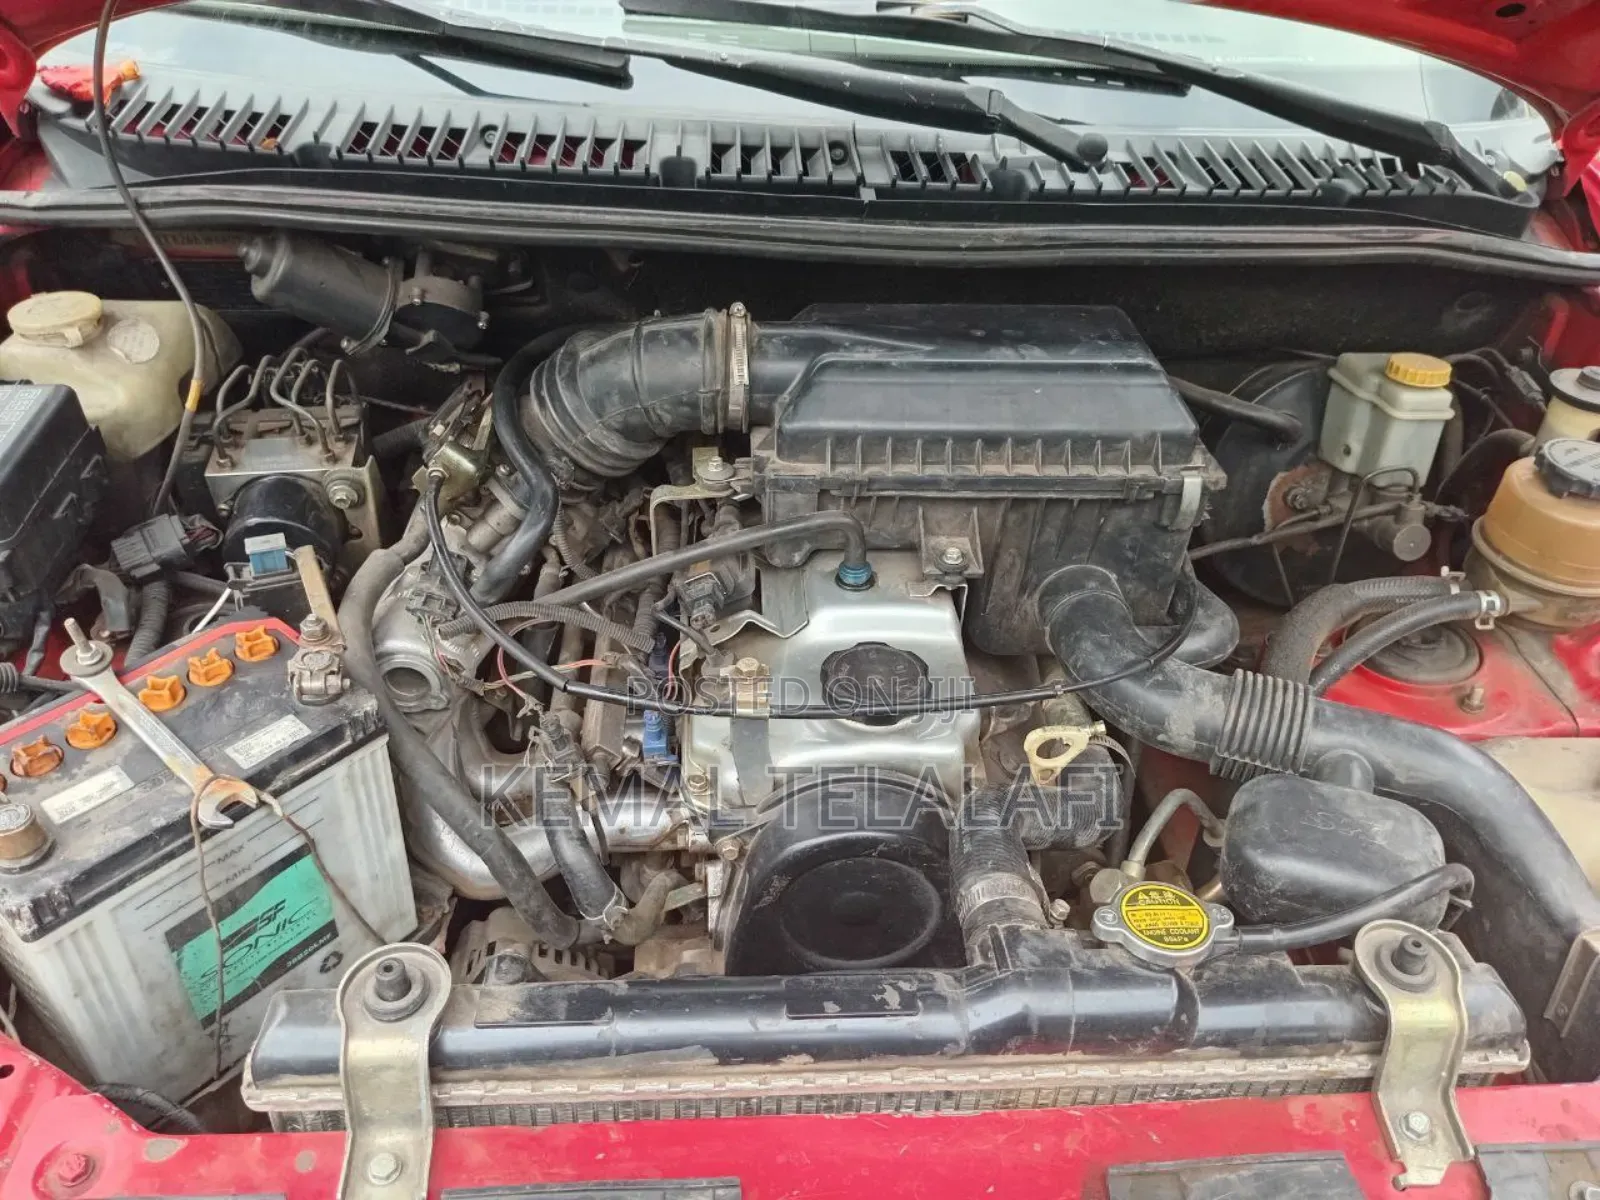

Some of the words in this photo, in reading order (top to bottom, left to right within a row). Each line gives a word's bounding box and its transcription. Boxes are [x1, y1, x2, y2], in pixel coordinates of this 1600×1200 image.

[217, 845, 244, 864] MAX
[225, 866, 252, 884] MIN
[200, 897, 319, 984] SONIC
